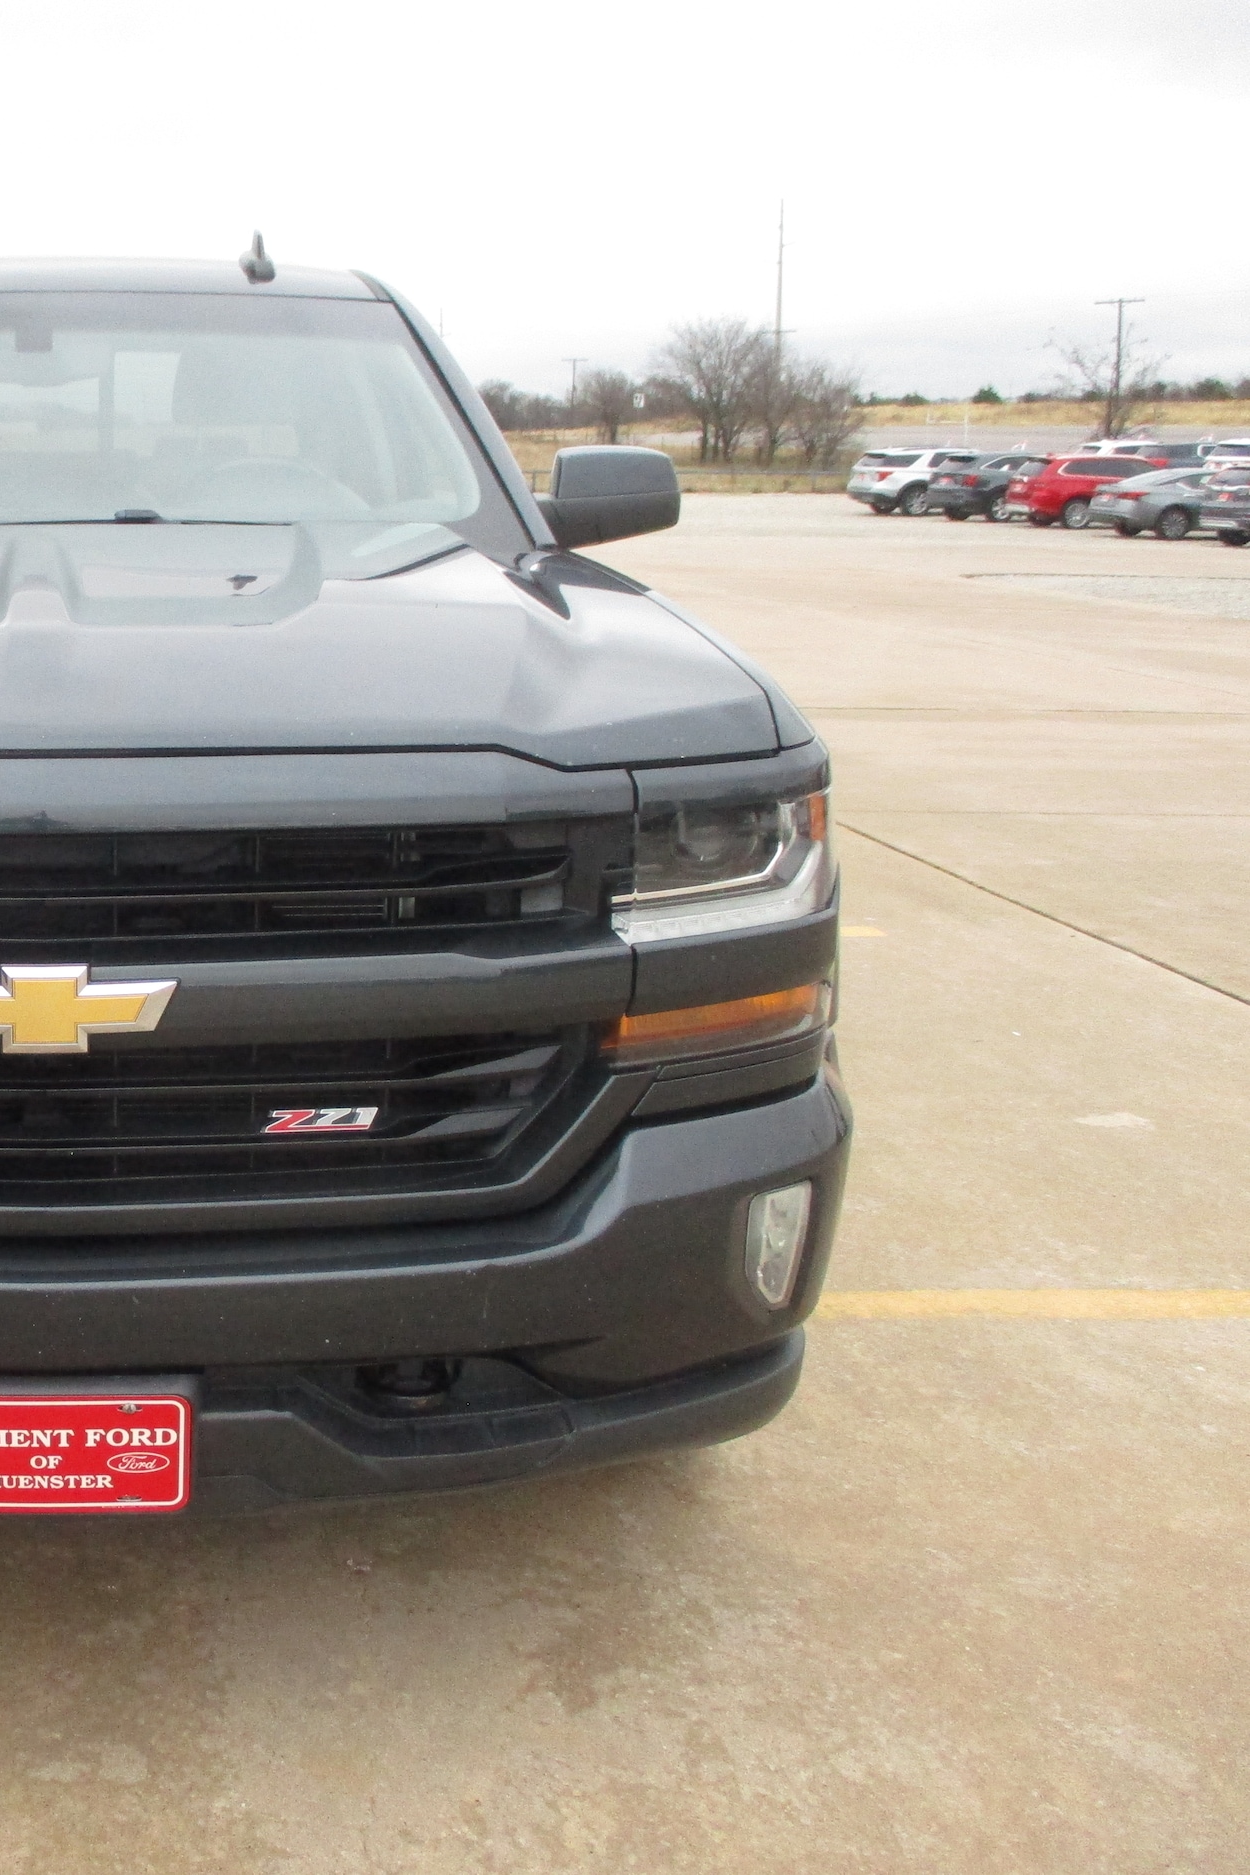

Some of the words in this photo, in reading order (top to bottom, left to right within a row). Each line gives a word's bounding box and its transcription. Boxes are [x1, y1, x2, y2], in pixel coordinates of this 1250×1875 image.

[263, 1106, 379, 1133] Z71
[84, 1428, 178, 1447] FORD
[29, 1455, 63, 1469] OF
[117, 1455, 157, 1471] Ford
